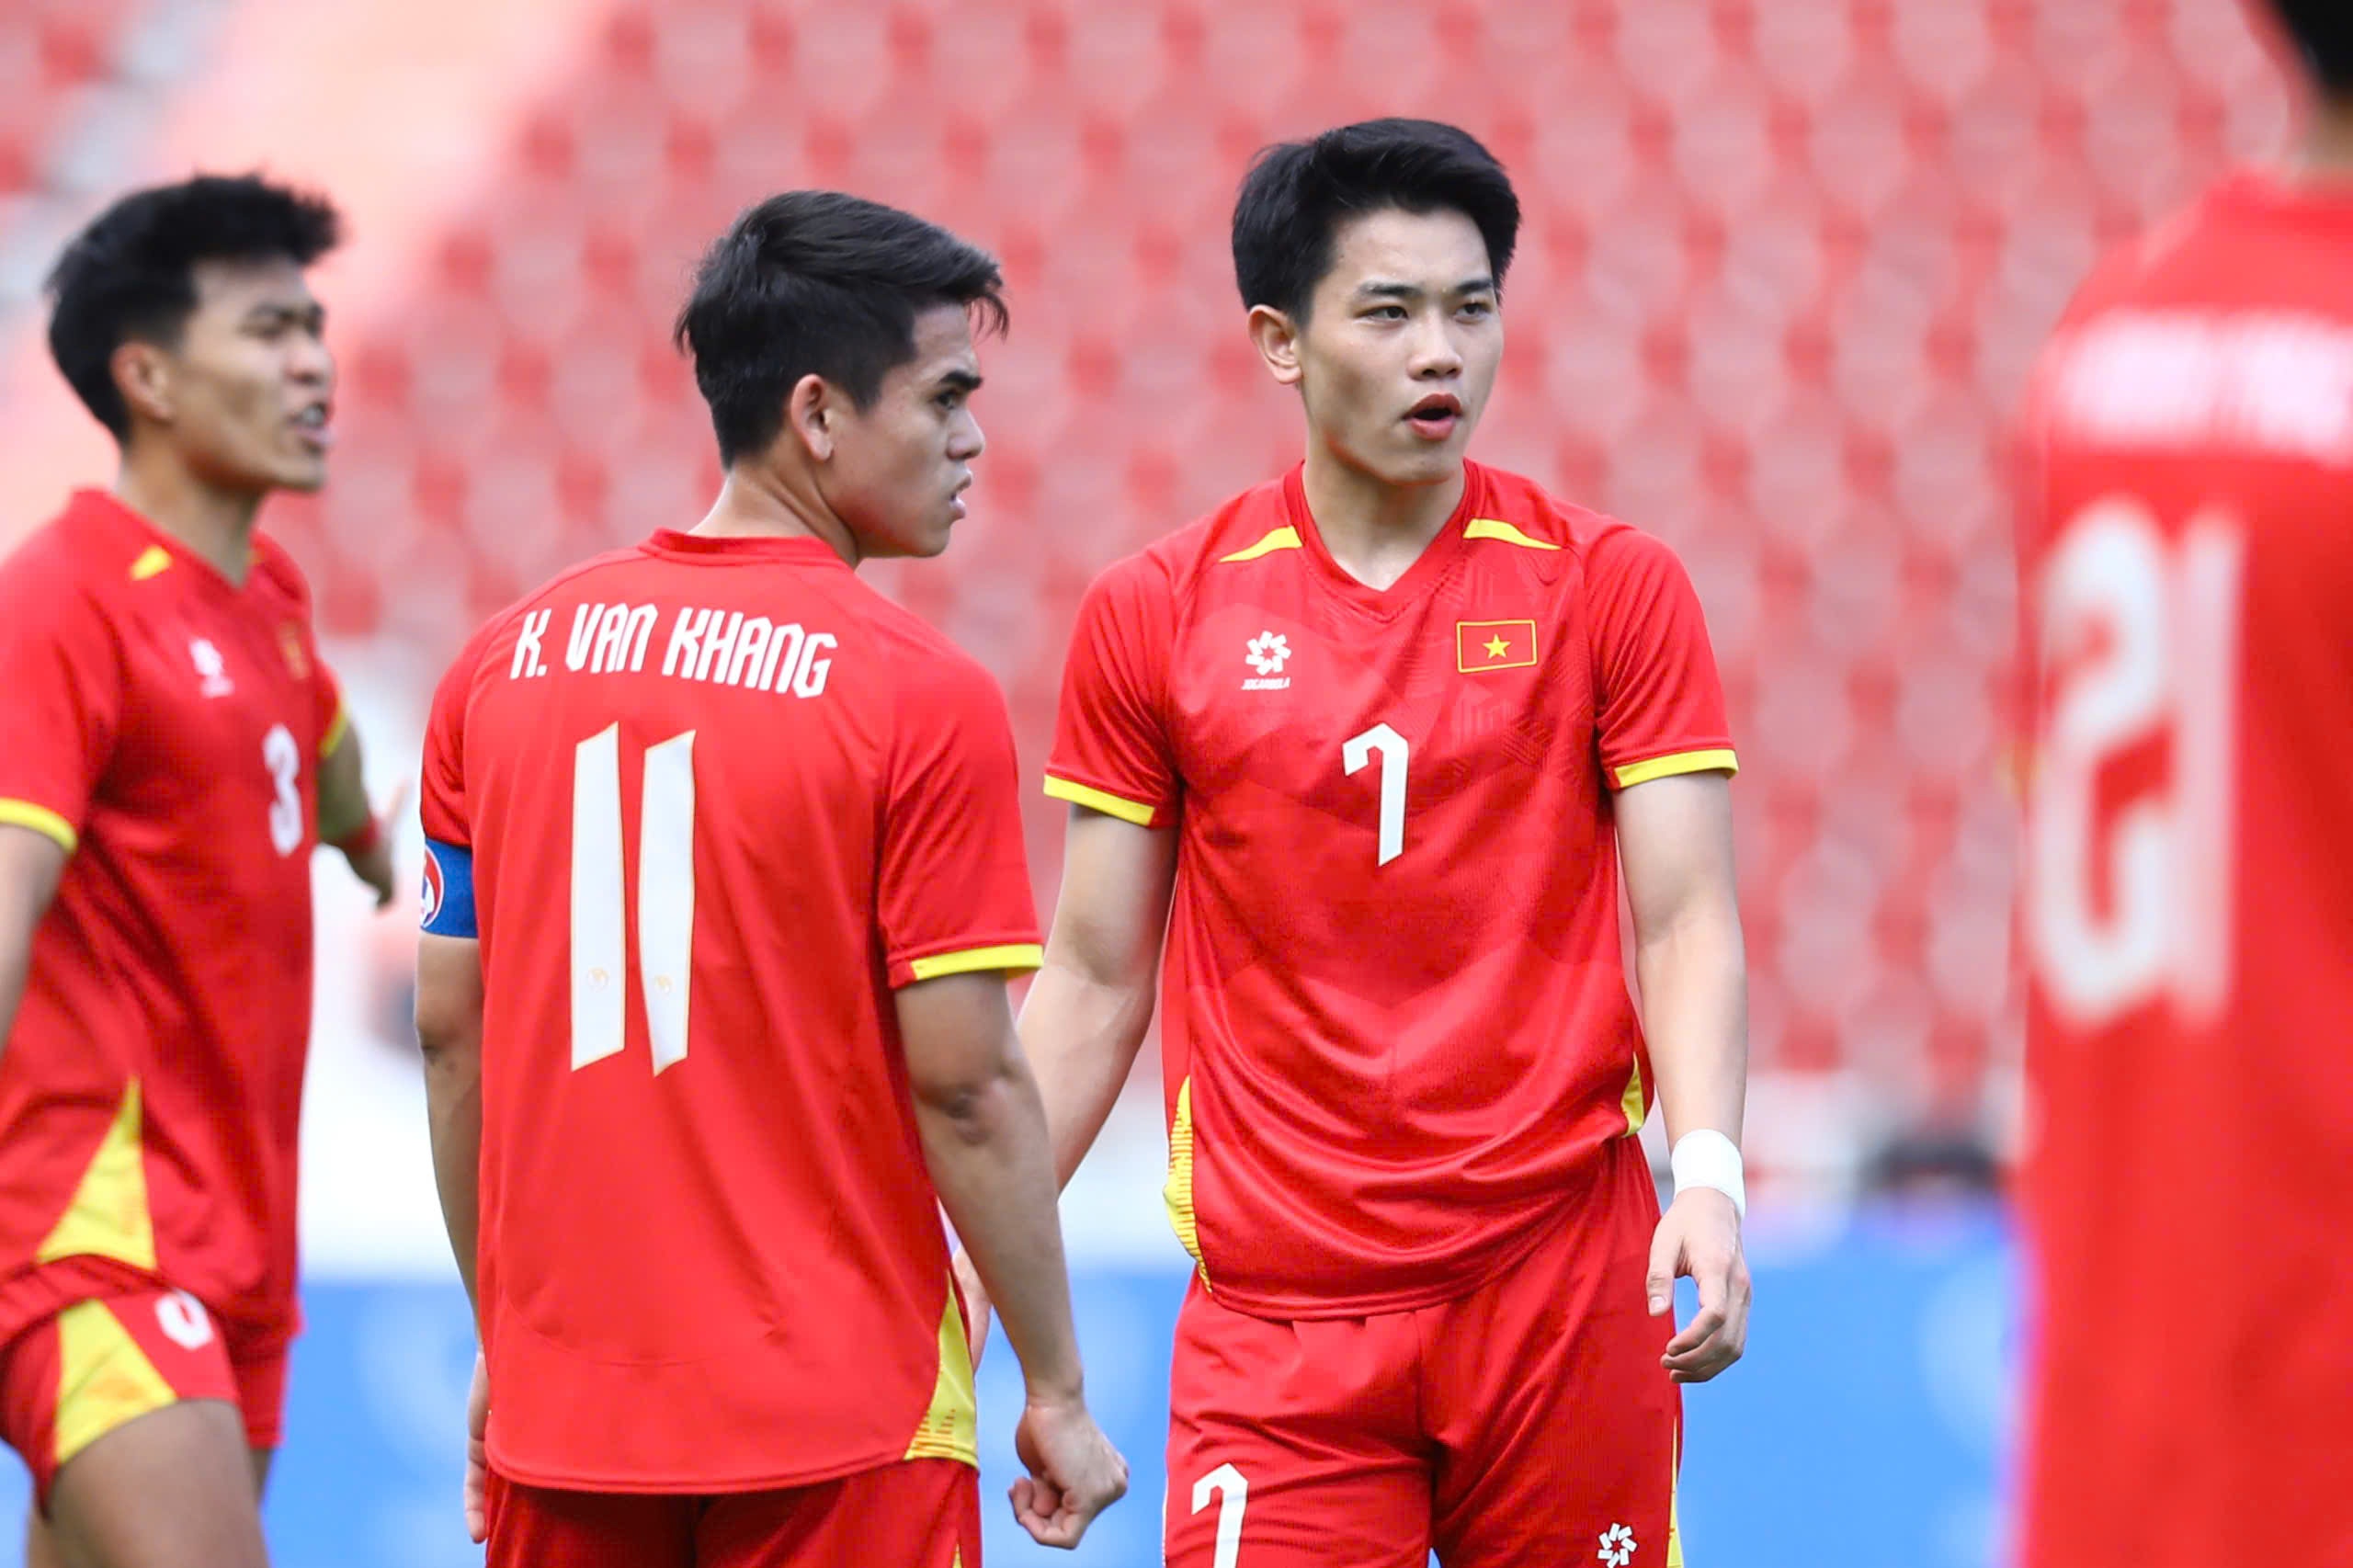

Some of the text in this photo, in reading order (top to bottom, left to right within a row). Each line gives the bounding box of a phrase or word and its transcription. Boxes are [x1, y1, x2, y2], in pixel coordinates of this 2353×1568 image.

[509, 602, 838, 699] K. VAN KHANG
[263, 722, 303, 857] 3
[1342, 722, 1409, 867] 7
[571, 721, 697, 1078] 11
[1191, 1462, 1249, 1568] 7
